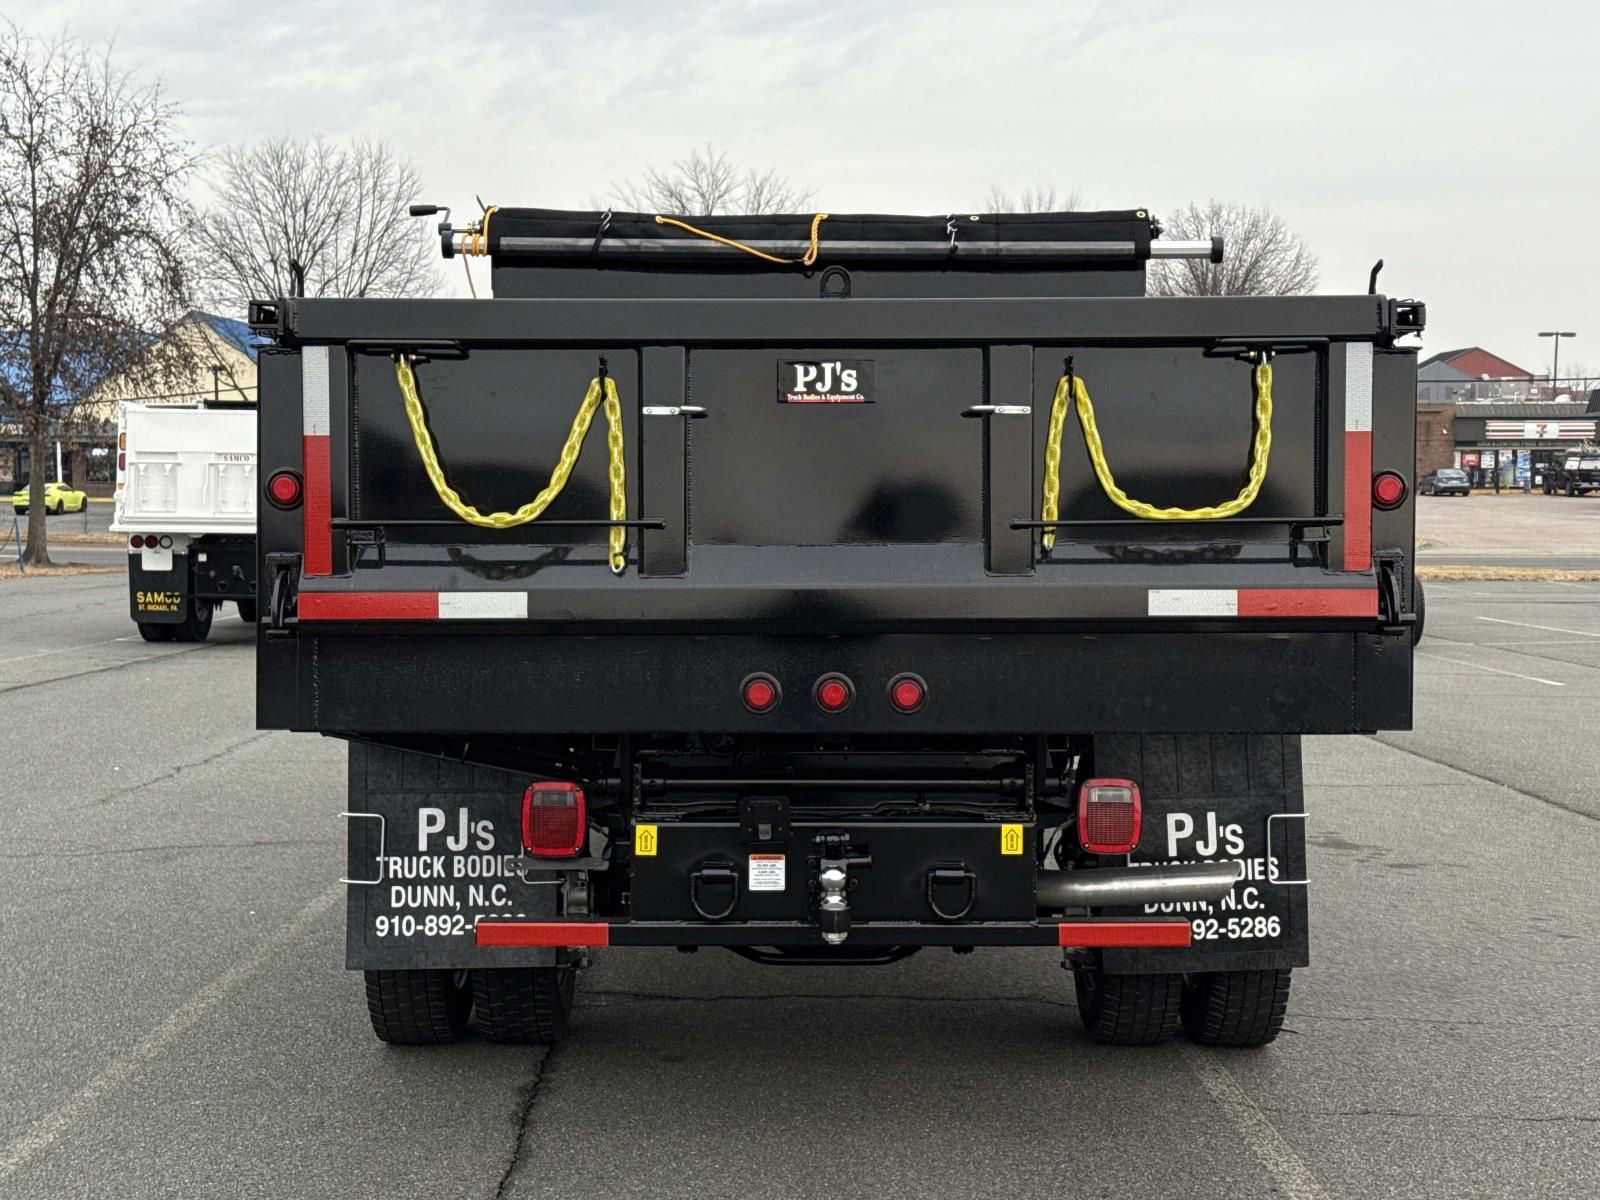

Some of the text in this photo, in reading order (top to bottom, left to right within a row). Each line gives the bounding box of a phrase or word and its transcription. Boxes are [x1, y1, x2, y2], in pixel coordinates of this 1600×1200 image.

[793, 361, 858, 392] PJ's
[136, 591, 181, 604] SAMCO
[391, 883, 513, 911] DUNN, N.C.
[375, 913, 526, 937] 910-892-
